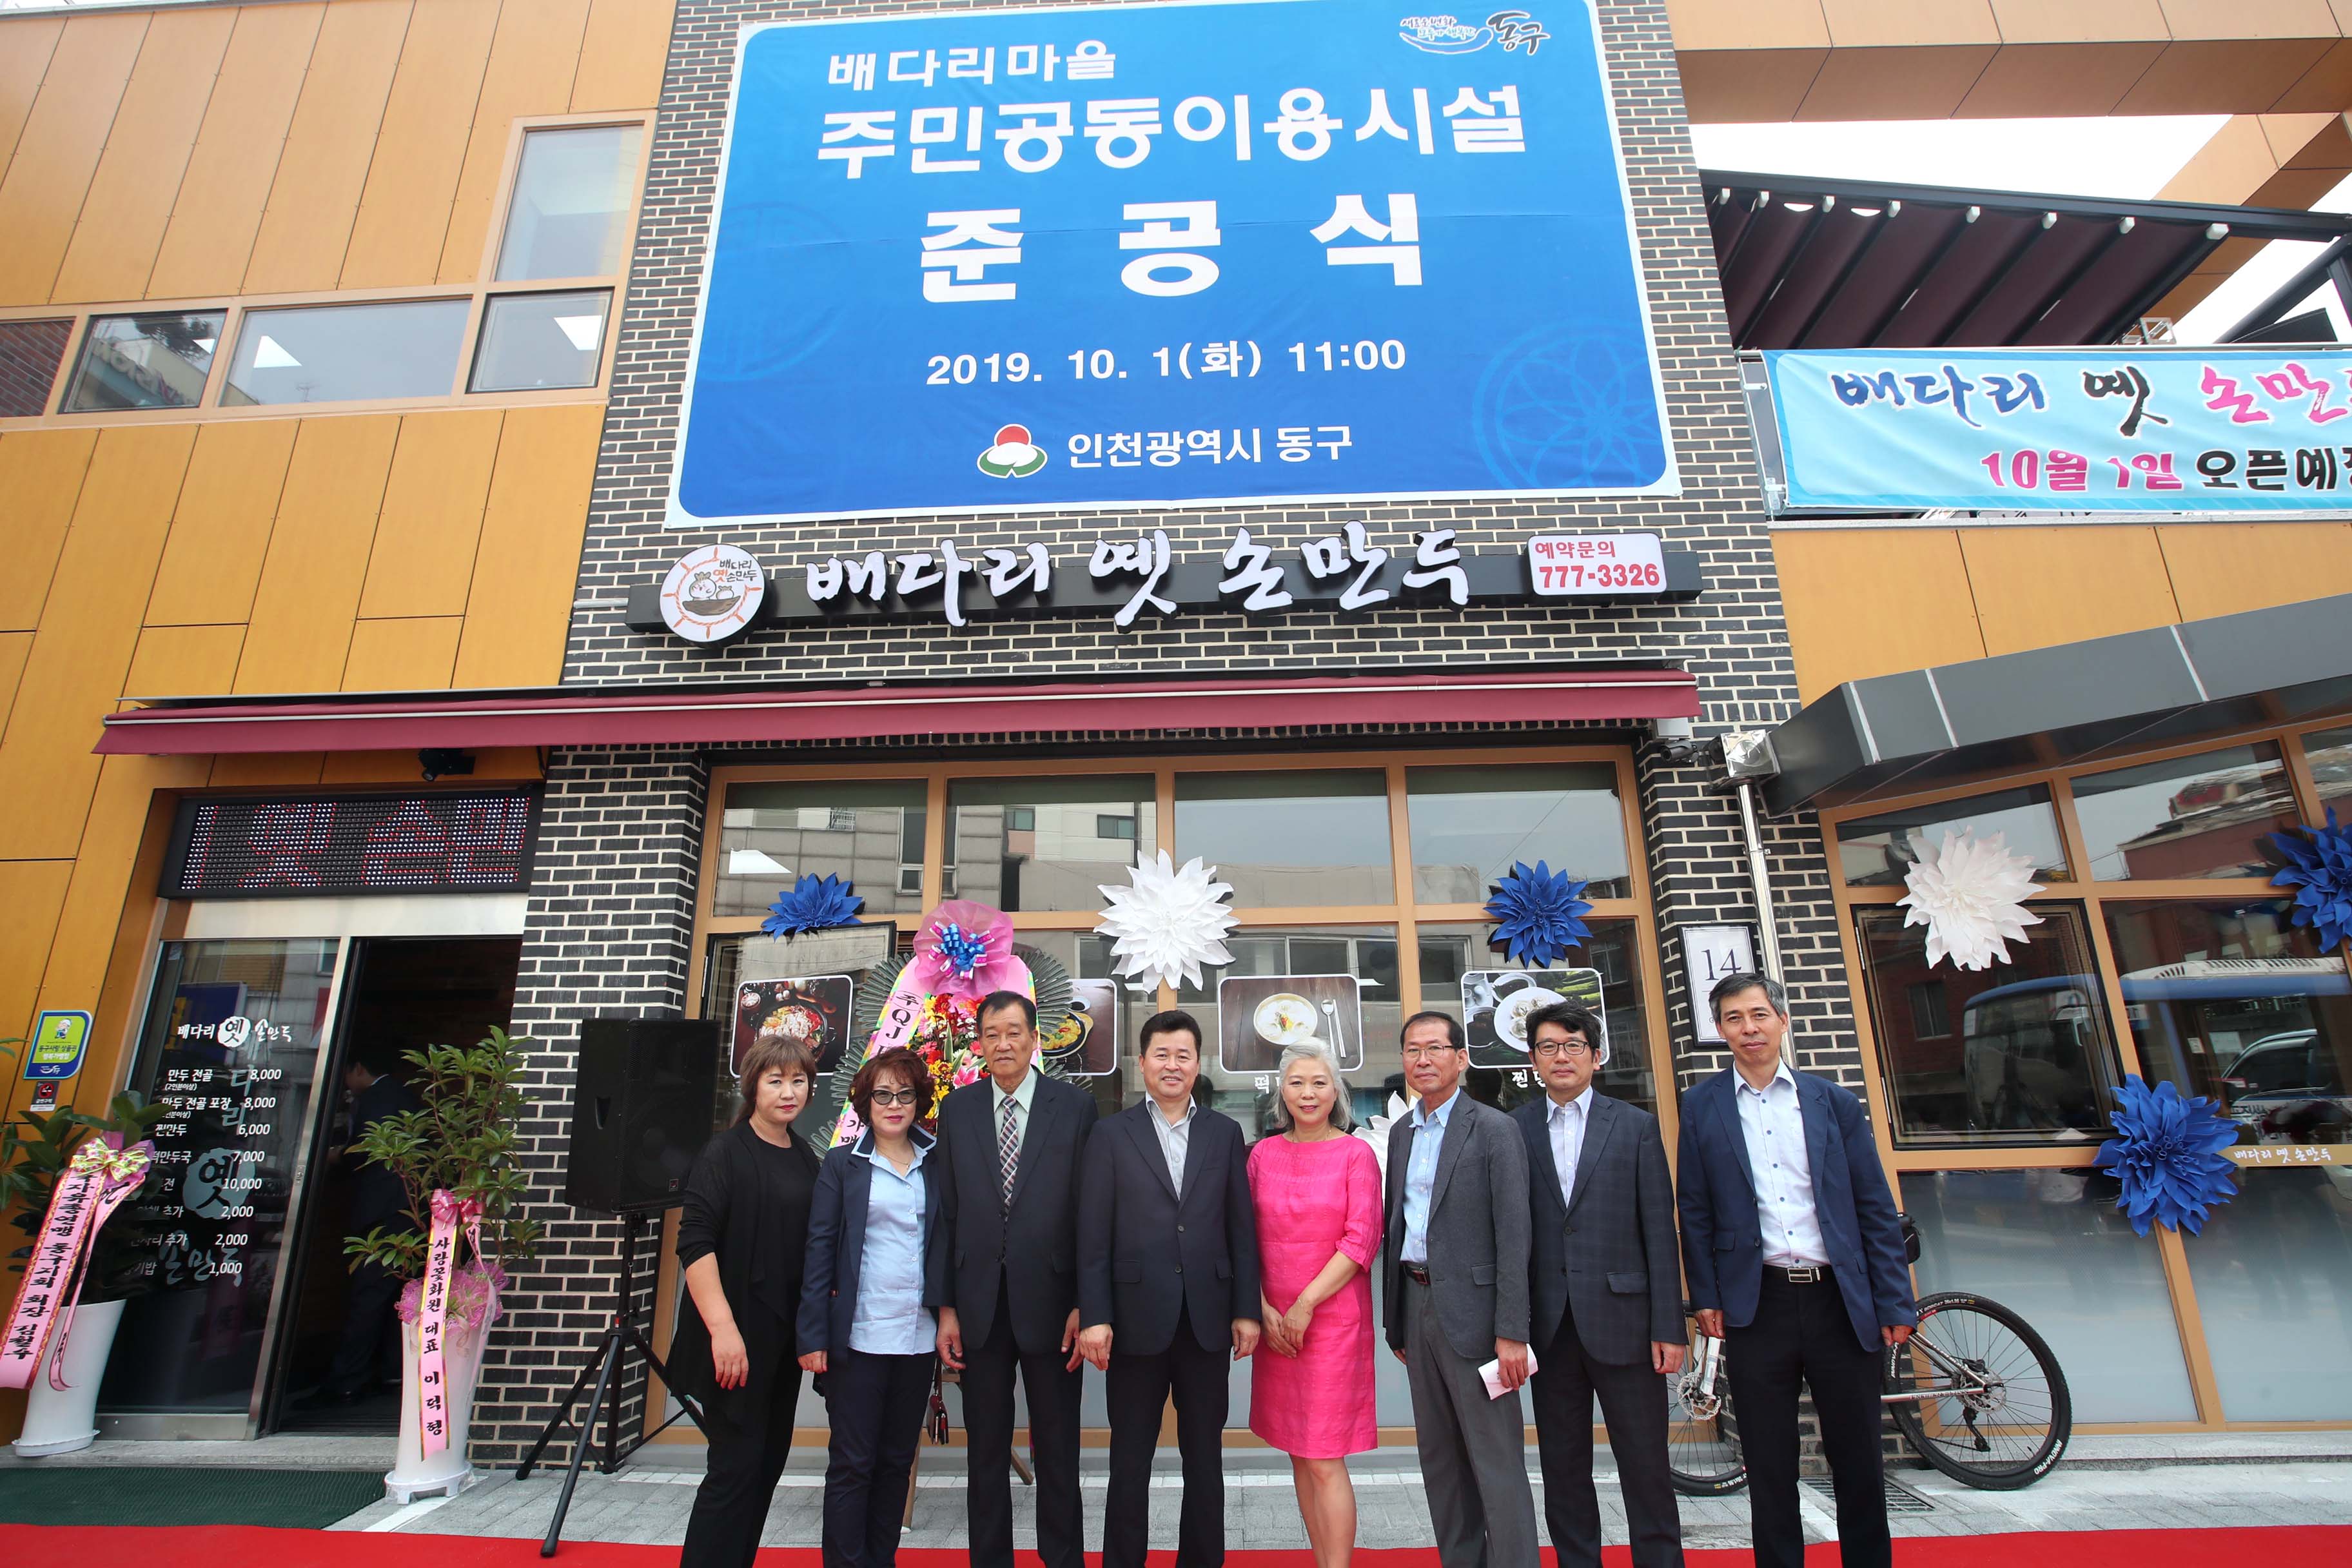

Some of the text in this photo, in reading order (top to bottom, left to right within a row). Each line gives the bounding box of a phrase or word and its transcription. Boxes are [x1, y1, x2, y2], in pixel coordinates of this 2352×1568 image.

[1486, 10, 1551, 55] 동구
[828, 40, 1115, 91] 배다리마을
[818, 84, 1525, 179] 주민공동이용시설
[926, 352, 1043, 386] 2019.
[1068, 349, 1128, 380] 10.
[1288, 339, 1406, 371] 11:00
[1831, 364, 2045, 428] 배다리
[2201, 363, 2352, 424] 손만
[1068, 426, 1353, 469] 인천광역시 동구
[1981, 449, 2088, 491] 10월
[2106, 453, 2182, 491] 1일
[1535, 540, 1616, 559] 예약문의
[720, 558, 752, 570] 배다리
[727, 569, 758, 582] 손만두
[806, 520, 1470, 633] 배다리 옛 손만두
[1539, 564, 1660, 589] 777-3326
[1701, 948, 1742, 981] 14
[177, 1024, 215, 1040] 배다리
[255, 1019, 291, 1043] 손만두
[168, 1069, 282, 1082] 만두 전골 8,000
[186, 1097, 206, 1110] 전골
[208, 1097, 231, 1110] 포장
[244, 1097, 276, 1110] 8,000
[155, 1124, 270, 1137] 찐만두 6,000
[233, 1151, 265, 1164] 7,000
[2234, 1148, 2272, 1163] 배다리
[2295, 1146, 2331, 1161] 손만두
[222, 1178, 262, 1191] 10,000
[220, 1206, 253, 1219] 2,000
[165, 1233, 188, 1246] 추가
[215, 1233, 248, 1248] 2,000
[29, 1242, 72, 1288] 동구지회
[209, 1262, 242, 1276] 1,000
[428, 1237, 450, 1313] 사랑꽃화원
[19, 1294, 51, 1318] 회장
[423, 1322, 440, 1355] 대표
[2034, 1438, 2063, 1475] INNOVA-PRO
